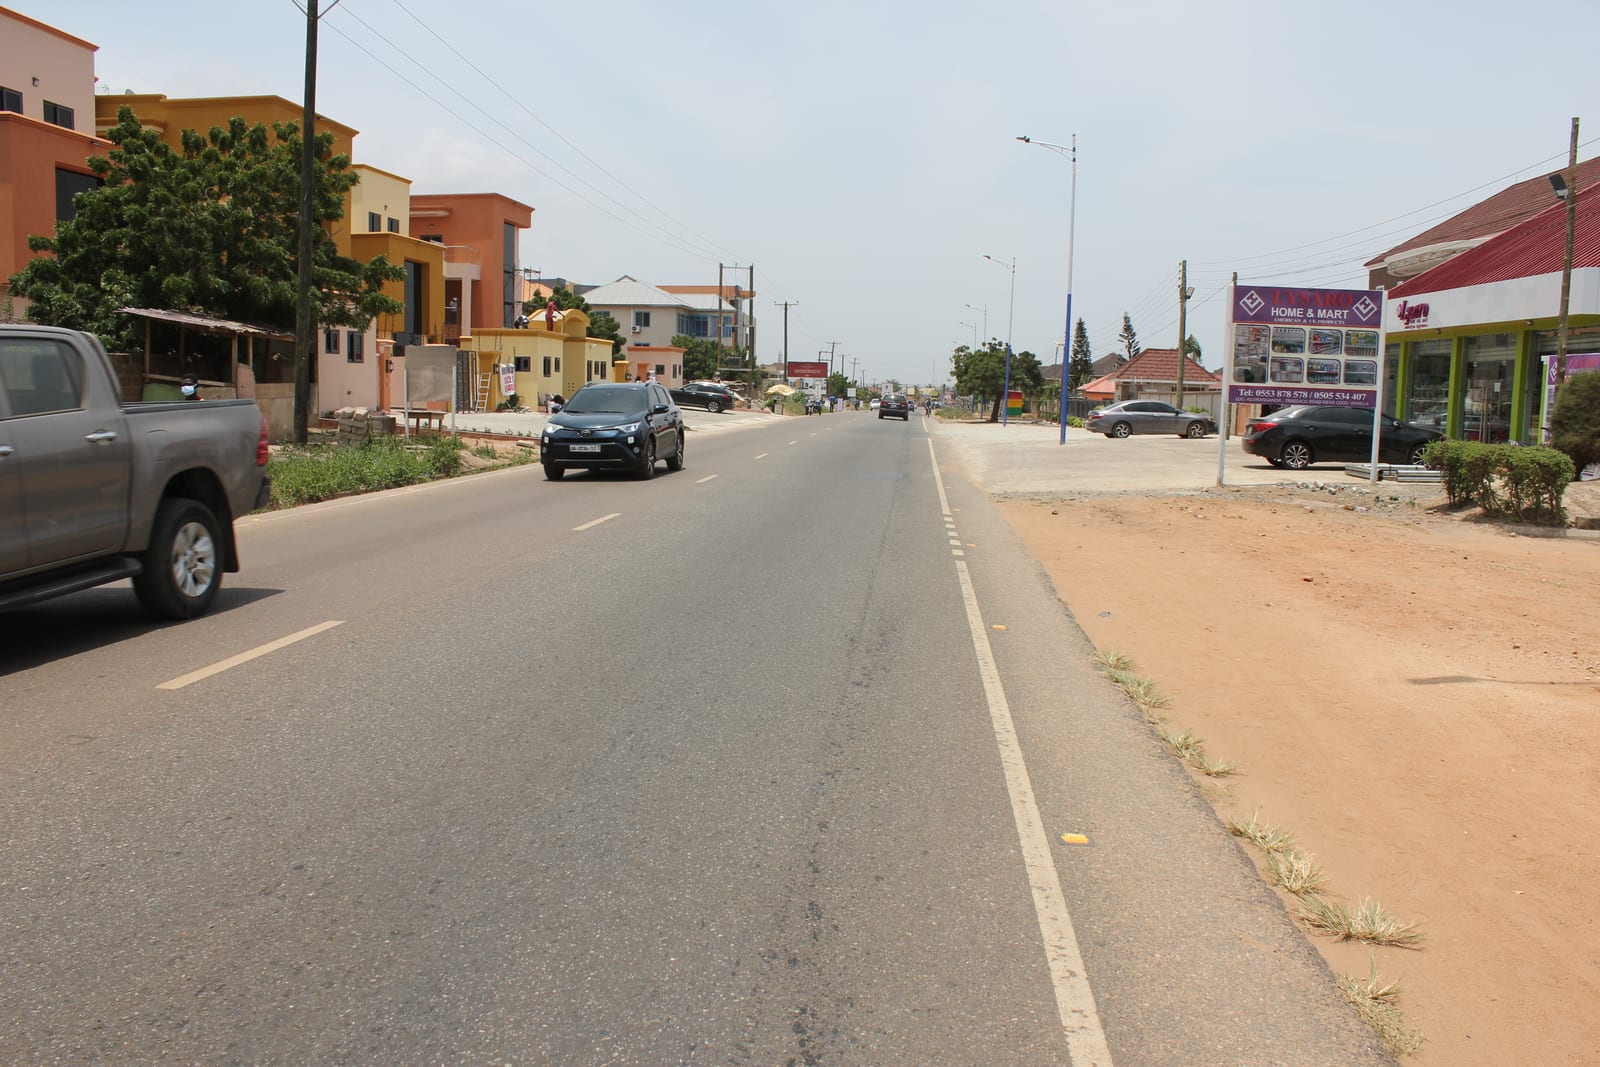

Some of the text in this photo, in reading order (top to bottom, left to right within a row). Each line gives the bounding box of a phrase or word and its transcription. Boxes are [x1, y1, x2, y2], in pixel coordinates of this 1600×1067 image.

[1272, 289, 1353, 307] LYSARO
[1271, 307, 1349, 320] HOME & MART
[1238, 388, 1254, 396] Tel:
[1314, 392, 1334, 400] 0505
[1352, 393, 1366, 401] 407
